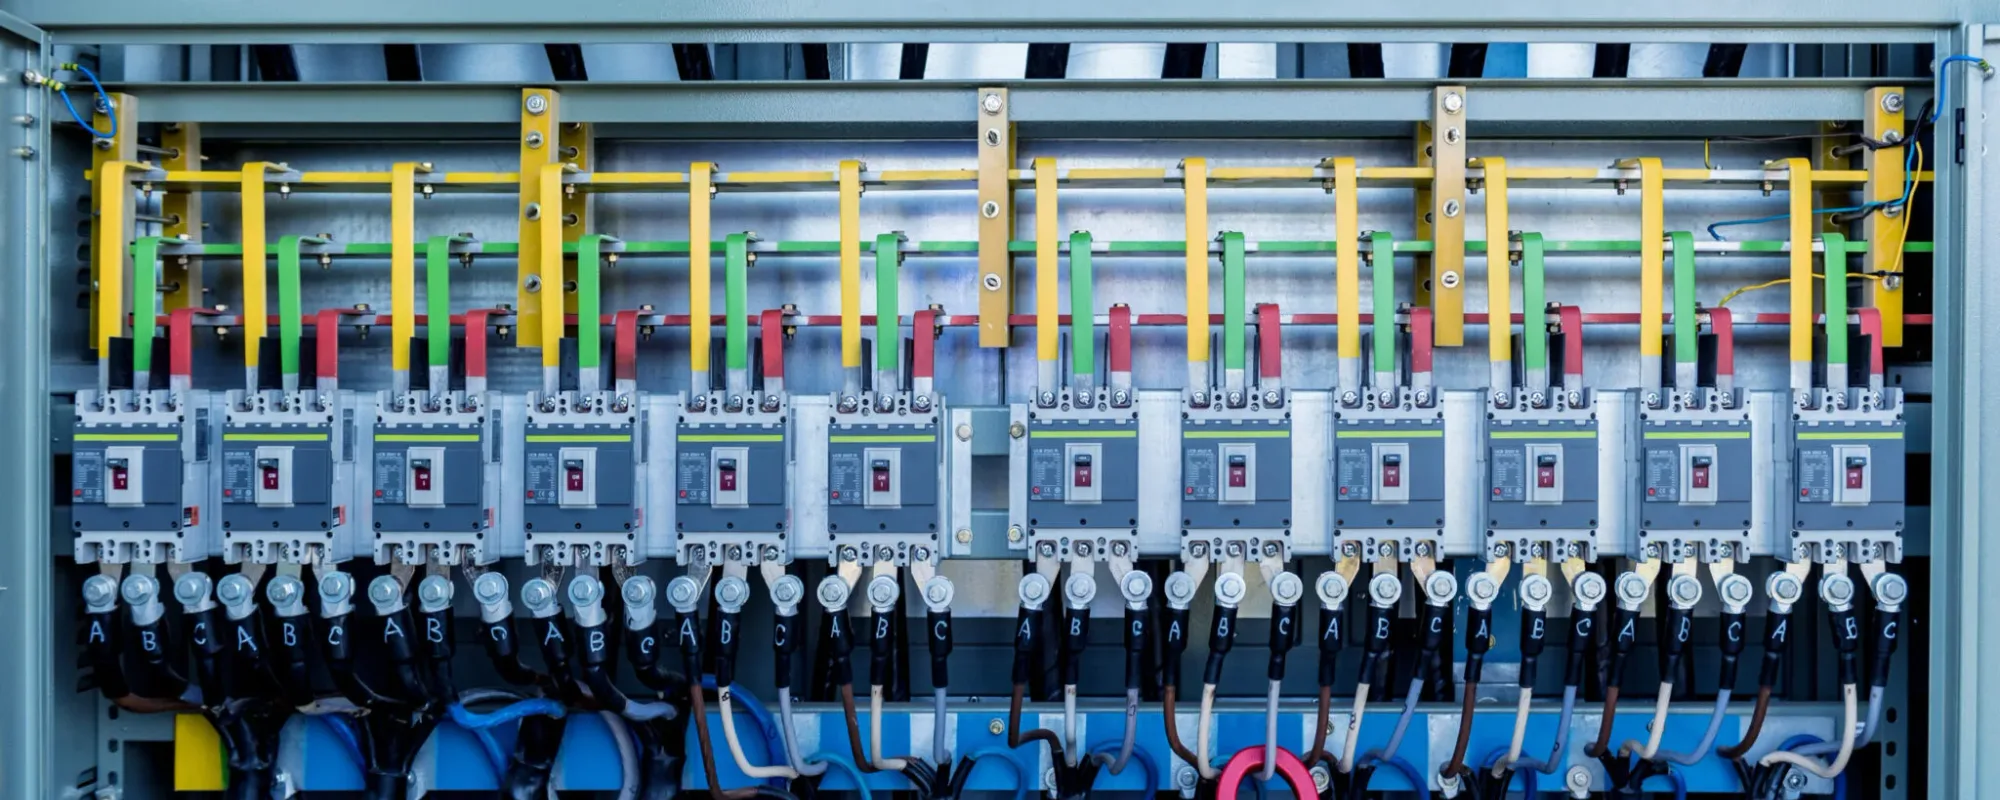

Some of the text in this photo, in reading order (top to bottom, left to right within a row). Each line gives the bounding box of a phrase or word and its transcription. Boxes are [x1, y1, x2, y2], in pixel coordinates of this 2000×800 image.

[90, 621, 104, 642] A
[195, 622, 206, 644] C
[284, 623, 296, 646] B
[385, 618, 404, 641] A
[428, 618, 443, 642] B
[545, 621, 564, 645] A
[680, 618, 696, 646] A
[721, 620, 731, 644] B
[776, 624, 786, 646] C
[831, 616, 840, 637] A
[876, 617, 888, 638] B
[935, 621, 947, 640] C
[1018, 616, 1030, 639] A
[1071, 617, 1080, 635] B
[1133, 620, 1142, 636] C
[1169, 621, 1180, 641] A
[1218, 617, 1228, 637] B
[1279, 617, 1290, 634] C
[1325, 618, 1338, 640] A
[1376, 617, 1388, 639] B
[1431, 617, 1441, 632] C
[1476, 619, 1487, 639] A
[1531, 618, 1543, 639] B
[1576, 618, 1591, 636] C
[1619, 618, 1634, 641] A
[1678, 617, 1690, 642] B
[1728, 621, 1741, 641] C
[1772, 620, 1786, 642] A
[1846, 617, 1857, 639] B
[1884, 622, 1896, 638] C
[142, 631, 156, 650] B
[238, 626, 257, 651] A
[329, 626, 343, 645] C
[590, 631, 604, 652] B
[641, 637, 654, 653] C
